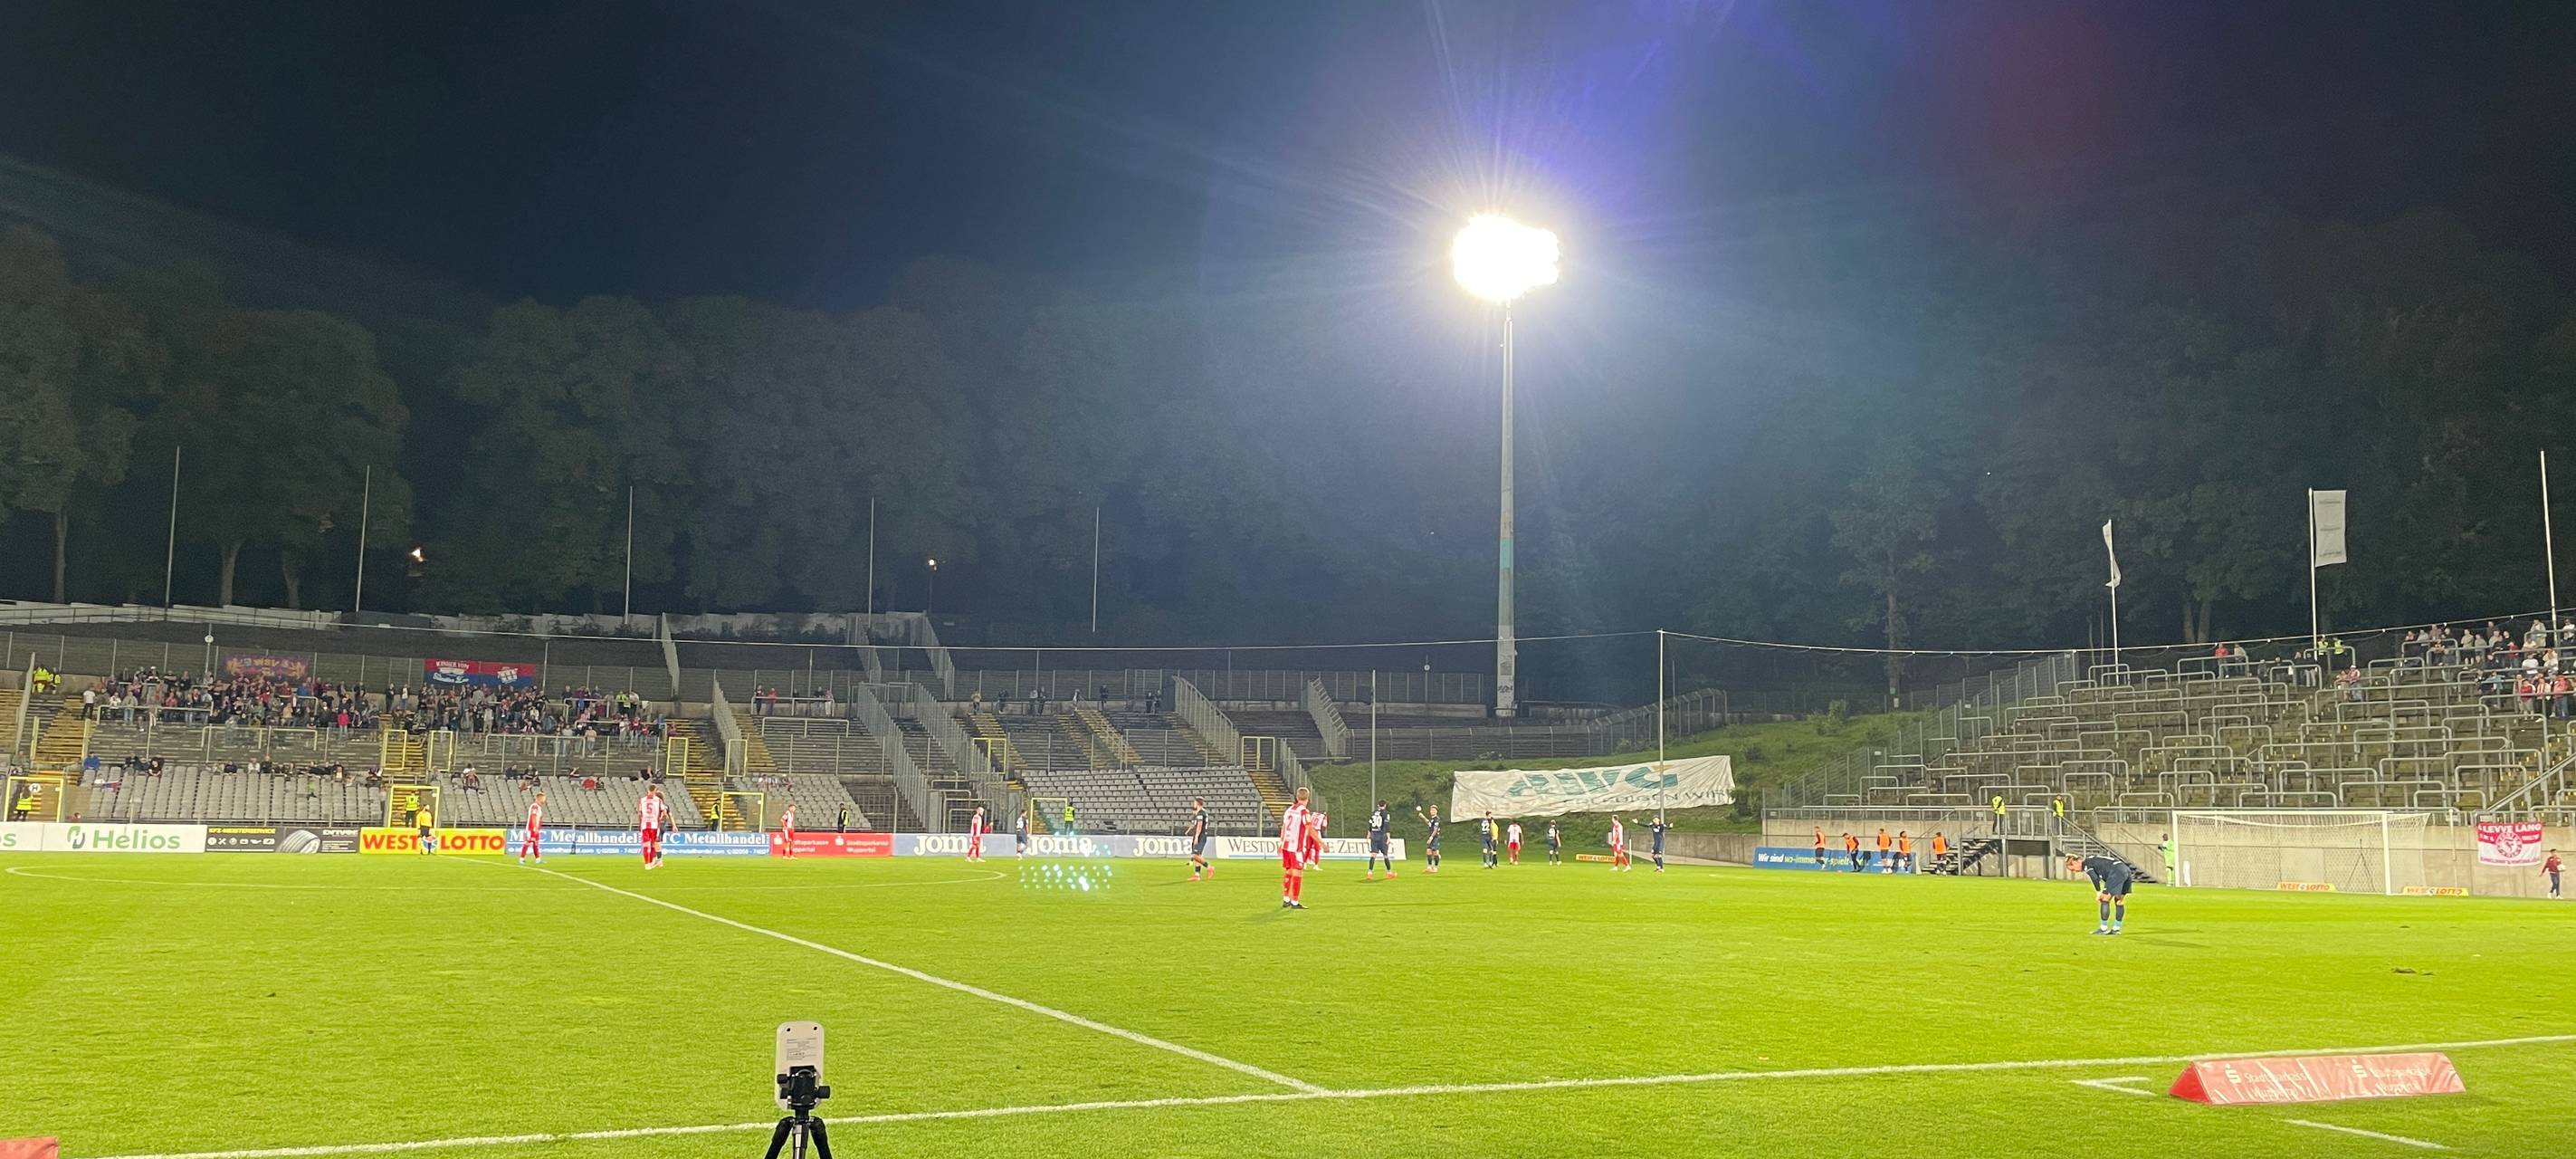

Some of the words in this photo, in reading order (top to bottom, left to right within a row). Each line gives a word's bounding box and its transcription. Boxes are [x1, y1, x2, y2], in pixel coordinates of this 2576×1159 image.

[646, 803, 653, 814] 5
[1286, 815, 1293, 831] 2
[1371, 815, 1383, 827] 30
[2515, 823, 2542, 832] LANG
[0, 832, 17, 848] s
[92, 829, 181, 849] Helios
[362, 834, 419, 850] WEST
[440, 835, 506, 850] LOTTO
[510, 829, 548, 842] MC
[550, 829, 638, 844] Metallhandel
[684, 833, 766, 845] Metallhandel
[1758, 853, 1769, 863] Wir
[1770, 853, 1784, 863] sind
